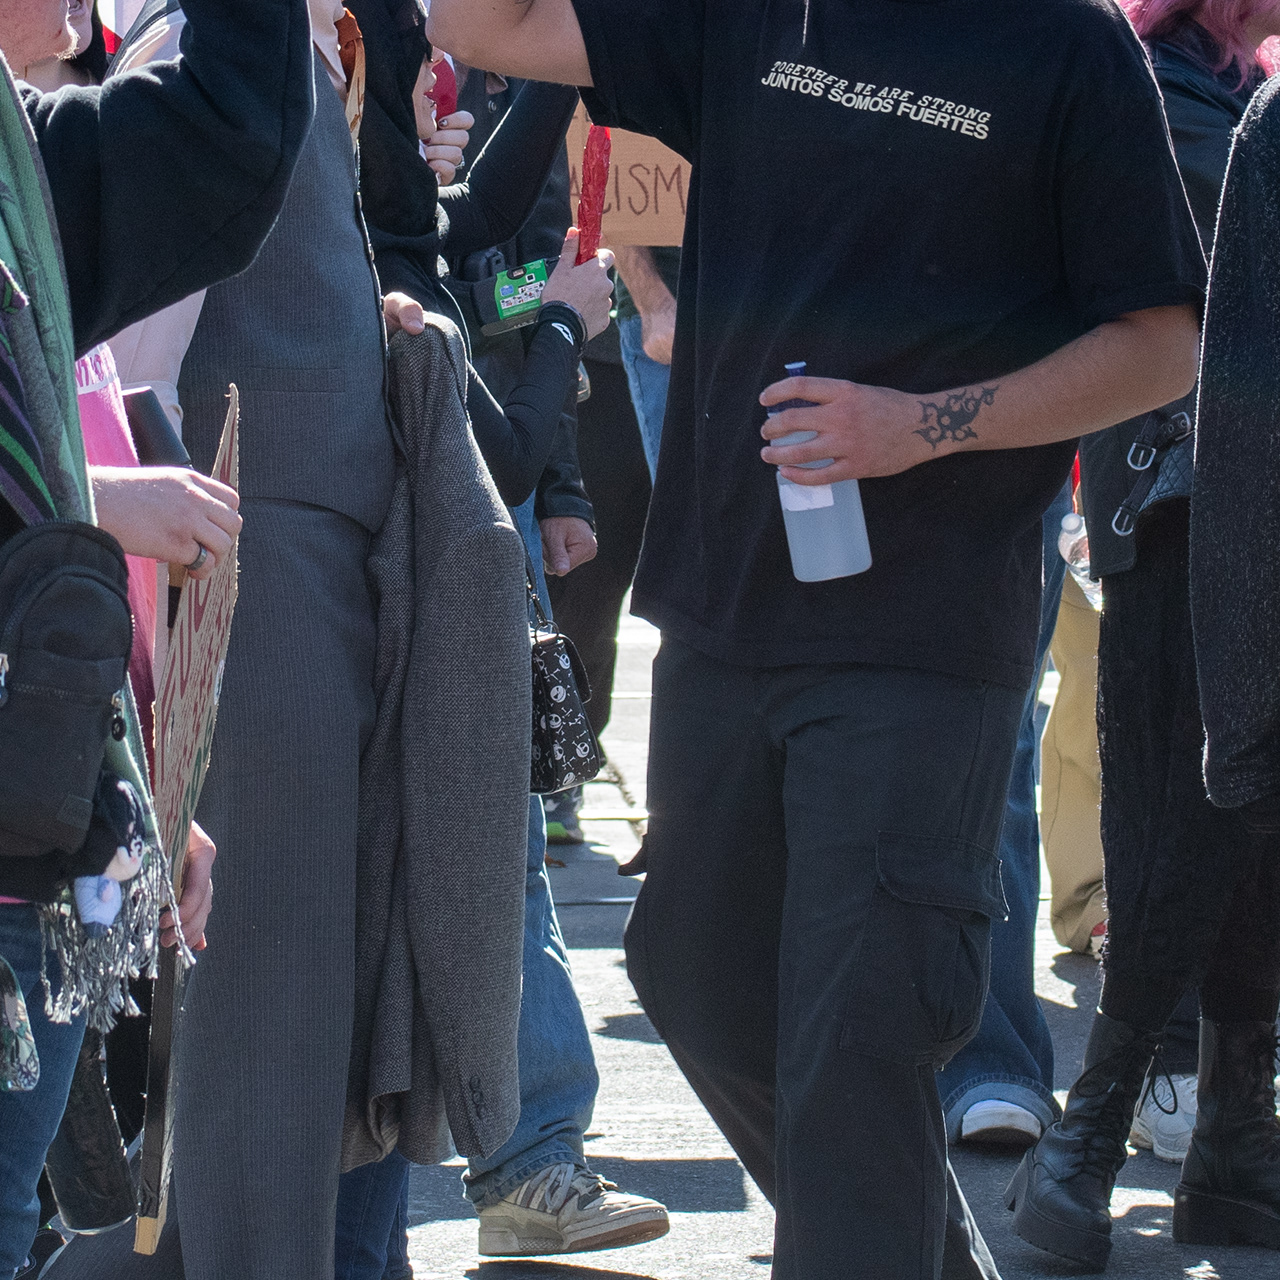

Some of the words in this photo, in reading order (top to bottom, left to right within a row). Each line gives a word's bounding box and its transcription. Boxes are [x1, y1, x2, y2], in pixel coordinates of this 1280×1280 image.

[760, 71, 826, 97] JUNTOS
[826, 87, 895, 114] SOMOS
[895, 101, 990, 141] FUERTES
[770, 60, 850, 91] TOGETHER
[853, 81, 877, 96] WE
[877, 86, 915, 102] ARE
[916, 95, 992, 125] STRONG
